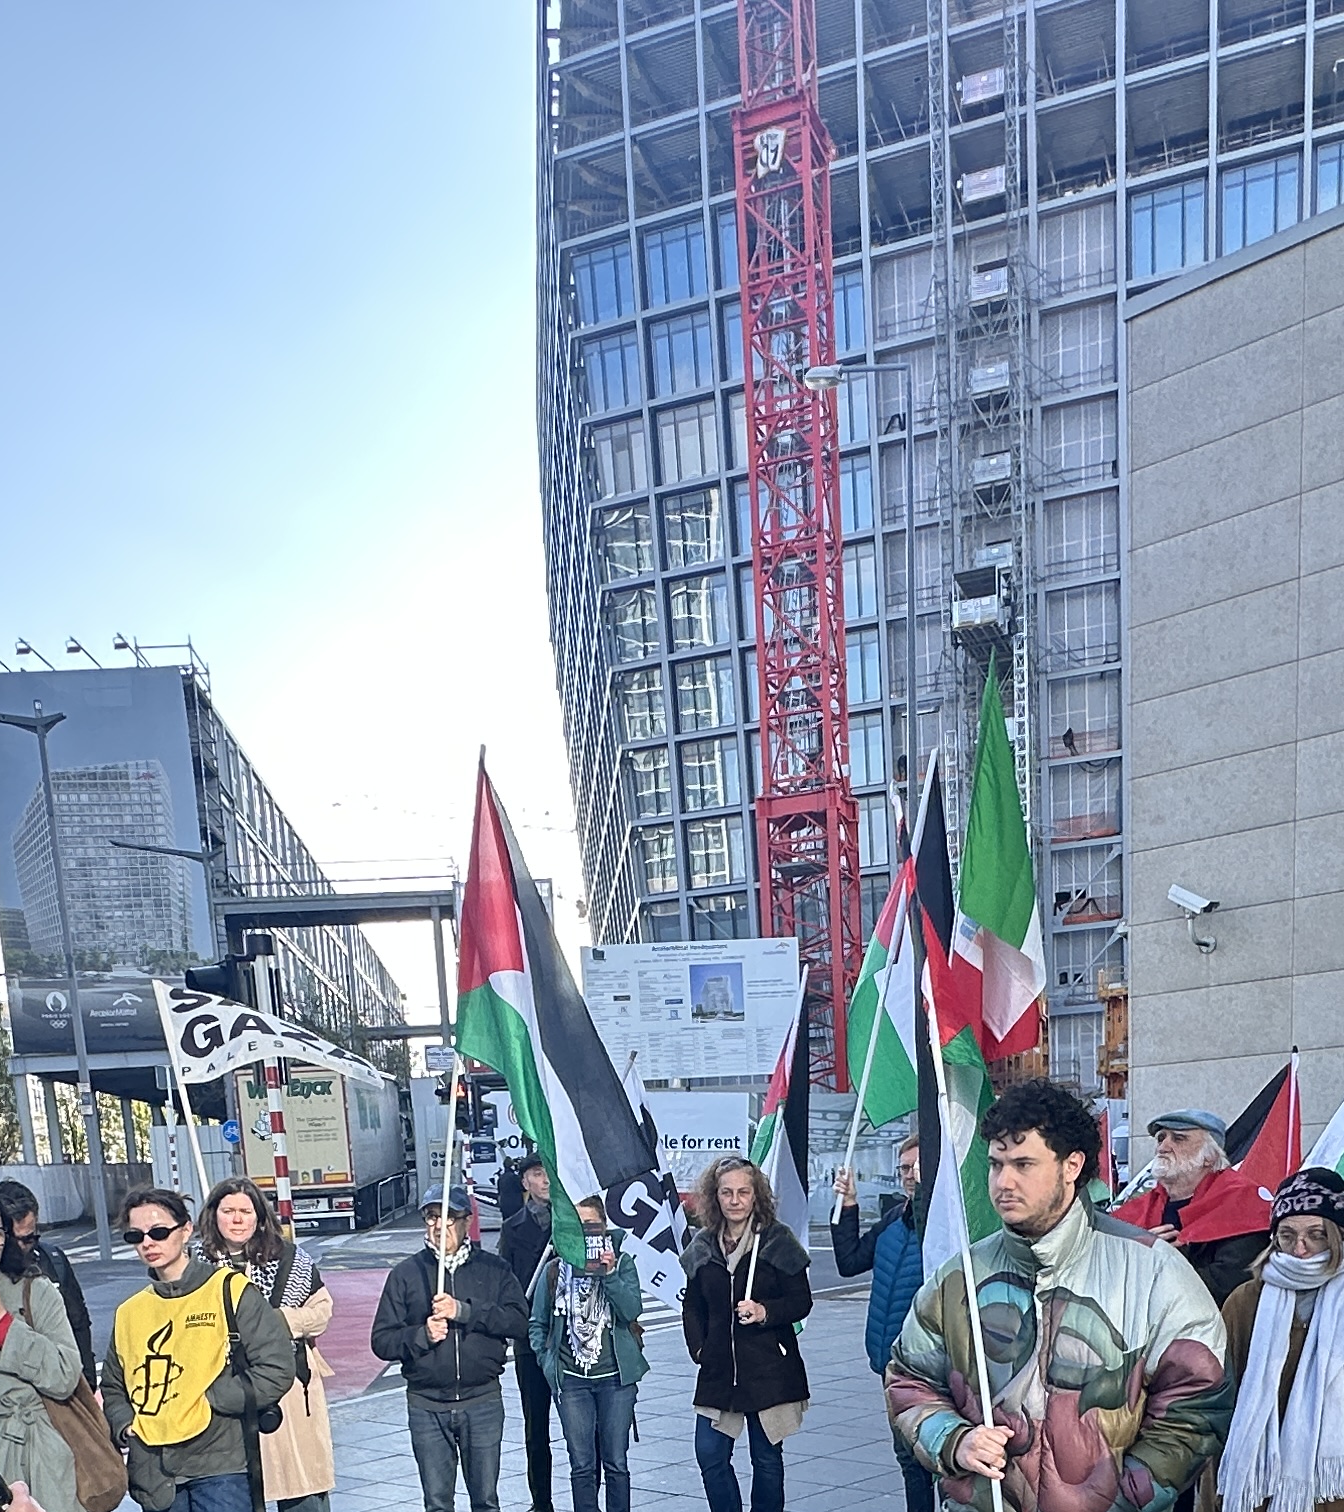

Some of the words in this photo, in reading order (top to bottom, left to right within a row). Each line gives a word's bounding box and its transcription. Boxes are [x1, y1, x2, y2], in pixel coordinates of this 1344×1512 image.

[659, 1134, 678, 1150] le
[681, 1134, 704, 1150] for
[707, 1135, 741, 1150] rent
